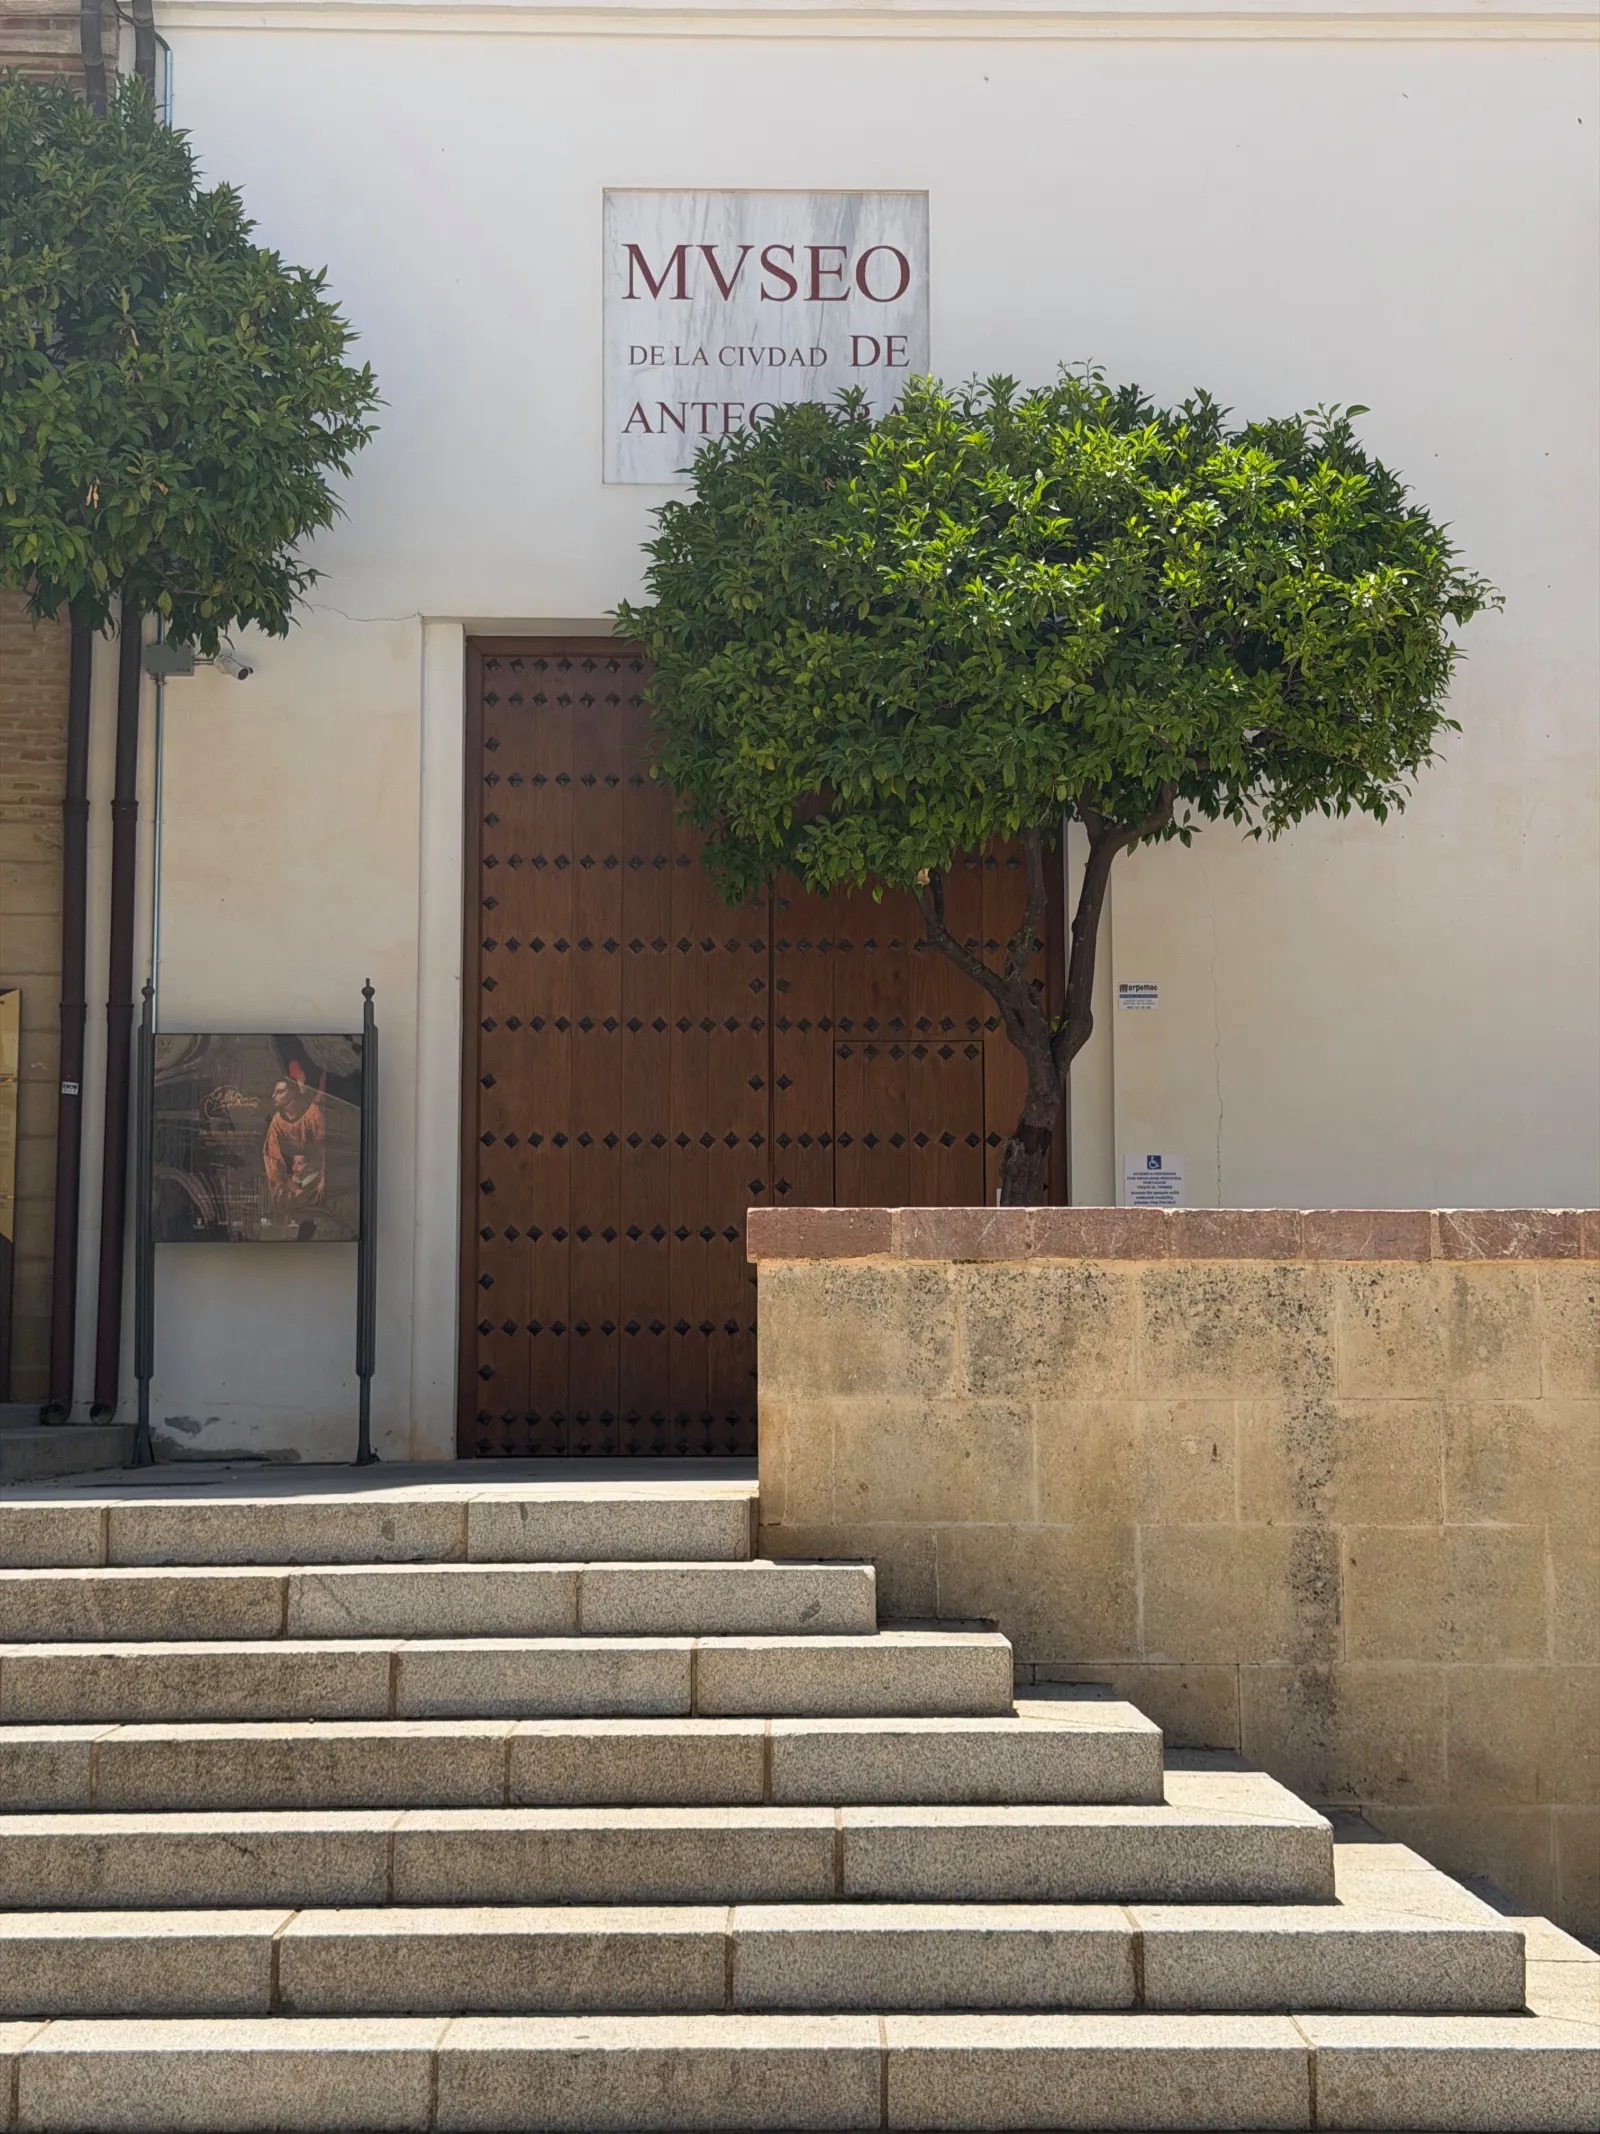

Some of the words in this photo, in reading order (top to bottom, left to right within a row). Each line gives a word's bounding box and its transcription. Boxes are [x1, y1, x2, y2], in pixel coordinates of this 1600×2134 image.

[621, 243, 911, 302] MVSEO
[628, 345, 665, 365] DE
[673, 346, 710, 366] LA
[718, 346, 828, 367] CIVDAD
[848, 335, 911, 367] DE
